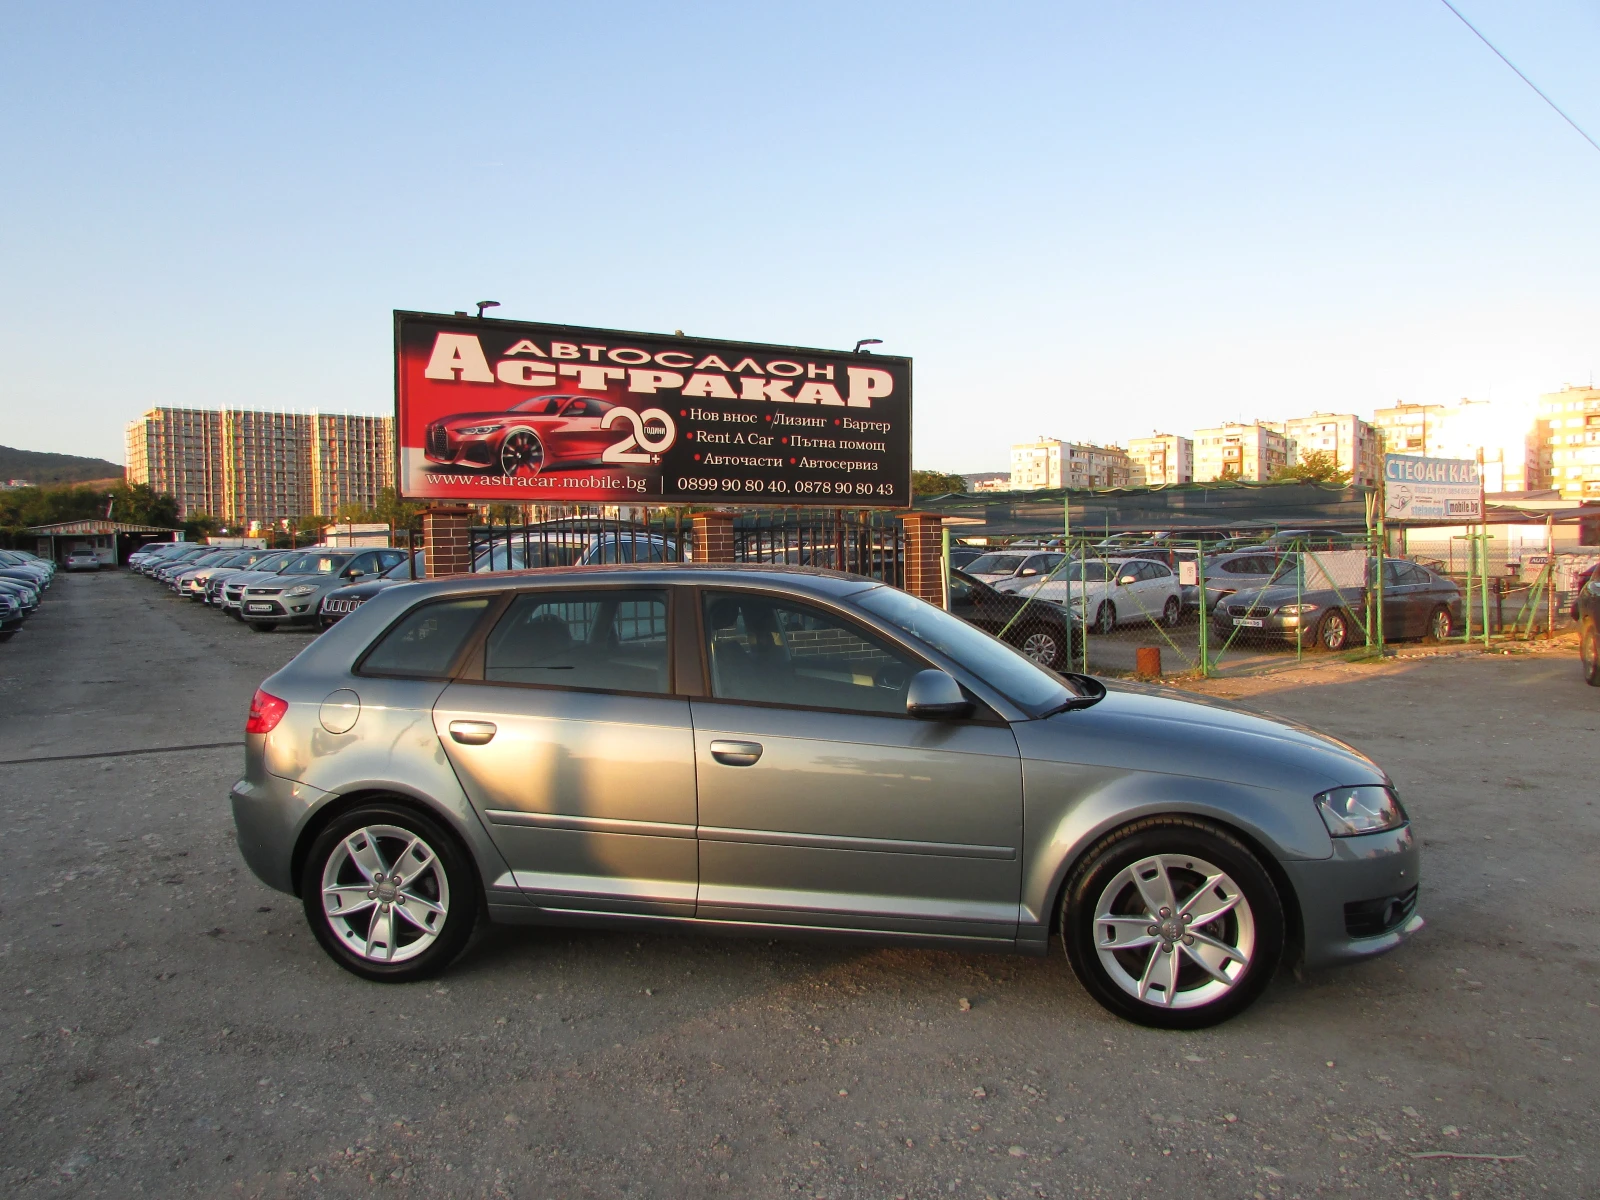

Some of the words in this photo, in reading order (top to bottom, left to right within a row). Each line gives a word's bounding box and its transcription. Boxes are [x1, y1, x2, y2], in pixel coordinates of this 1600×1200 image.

[504, 339, 834, 380] АВТОСАЛОН
[424, 332, 893, 408] АСТРАКАР
[690, 408, 719, 421] Нов
[723, 412, 757, 423] внос
[773, 413, 827, 428] Лизинг
[644, 426, 665, 434] ГОДИНИ
[843, 417, 891, 434] Бартер
[696, 430, 731, 444] Rent
[734, 433, 745, 444] A
[748, 433, 774, 446] Car
[790, 435, 836, 449] Пътна
[839, 440, 886, 453] помощ
[703, 452, 783, 467] Авточасти
[799, 456, 878, 472] Автосервиз
[1386, 459, 1446, 482] СТЕФАН
[1449, 464, 1478, 483] КАР
[425, 472, 647, 492] www.astracar.mobile.bg
[677, 477, 718, 491] 0899
[721, 478, 741, 491] 90
[744, 479, 764, 492] 80
[794, 480, 831, 494] 0878
[834, 481, 853, 494] 90
[855, 482, 874, 495] 80
[876, 483, 894, 495] 43
